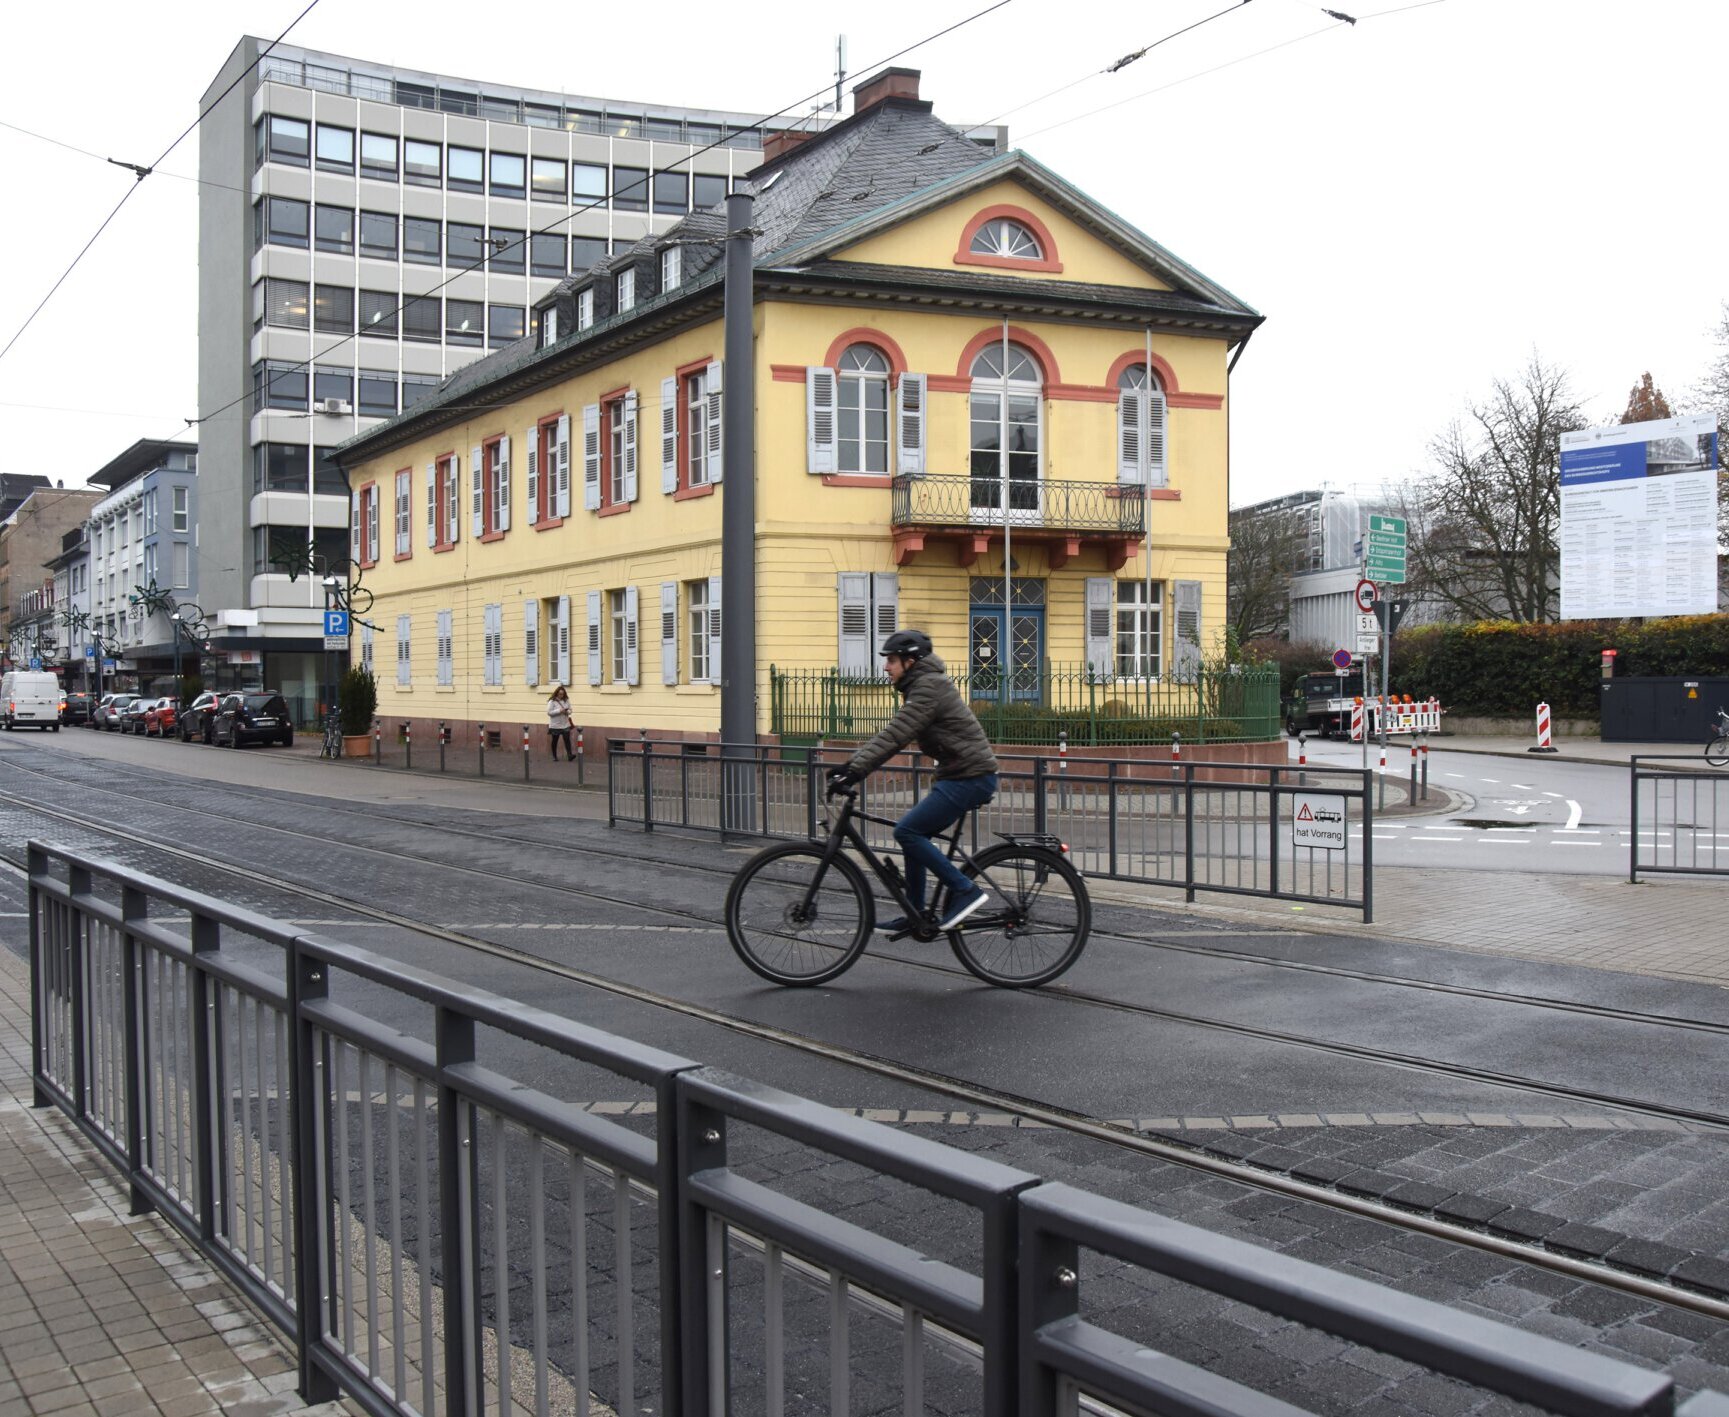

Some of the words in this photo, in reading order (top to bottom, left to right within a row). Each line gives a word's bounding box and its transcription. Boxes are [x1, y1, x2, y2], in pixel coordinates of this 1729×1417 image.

[330, 614, 343, 633] P
[1296, 828, 1309, 837] hat
[1310, 829, 1342, 841] Vorrang
